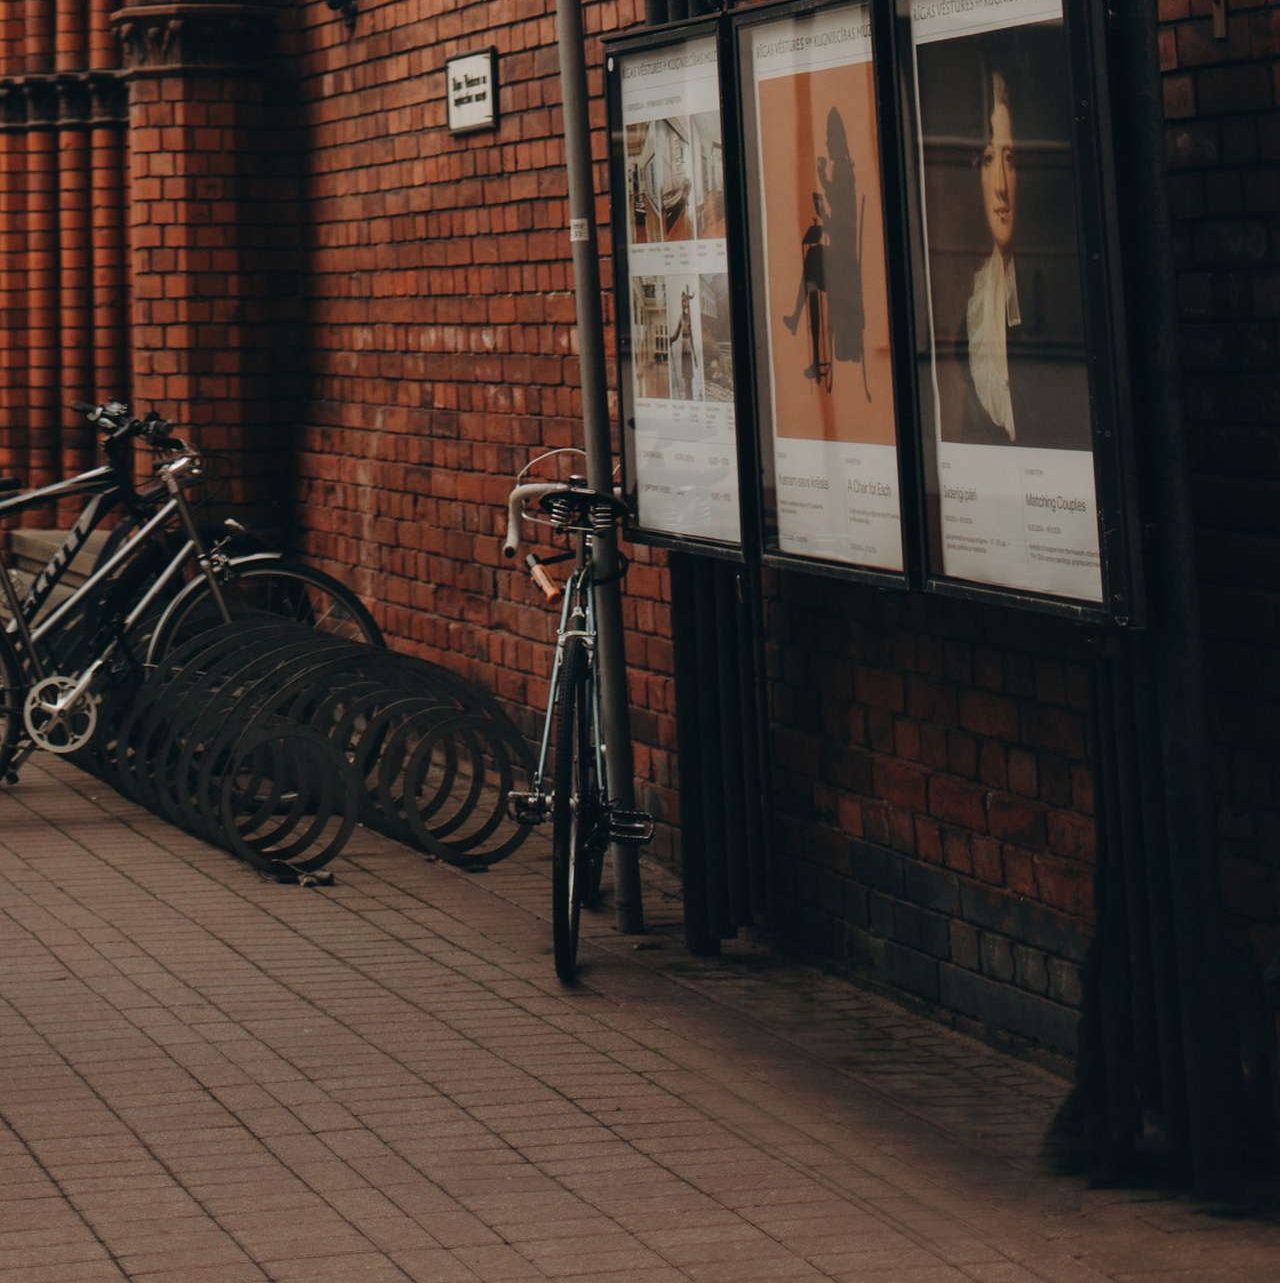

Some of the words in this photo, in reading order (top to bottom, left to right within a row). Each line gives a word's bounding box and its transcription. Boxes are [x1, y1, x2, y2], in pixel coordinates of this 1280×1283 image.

[912, 3, 937, 22] RĪGAS
[847, 480, 853, 493] A
[854, 480, 868, 494] Chair
[868, 481, 877, 496] for
[877, 482, 892, 497] Each
[1025, 492, 1057, 513] Matching
[1057, 495, 1087, 513] Couples
